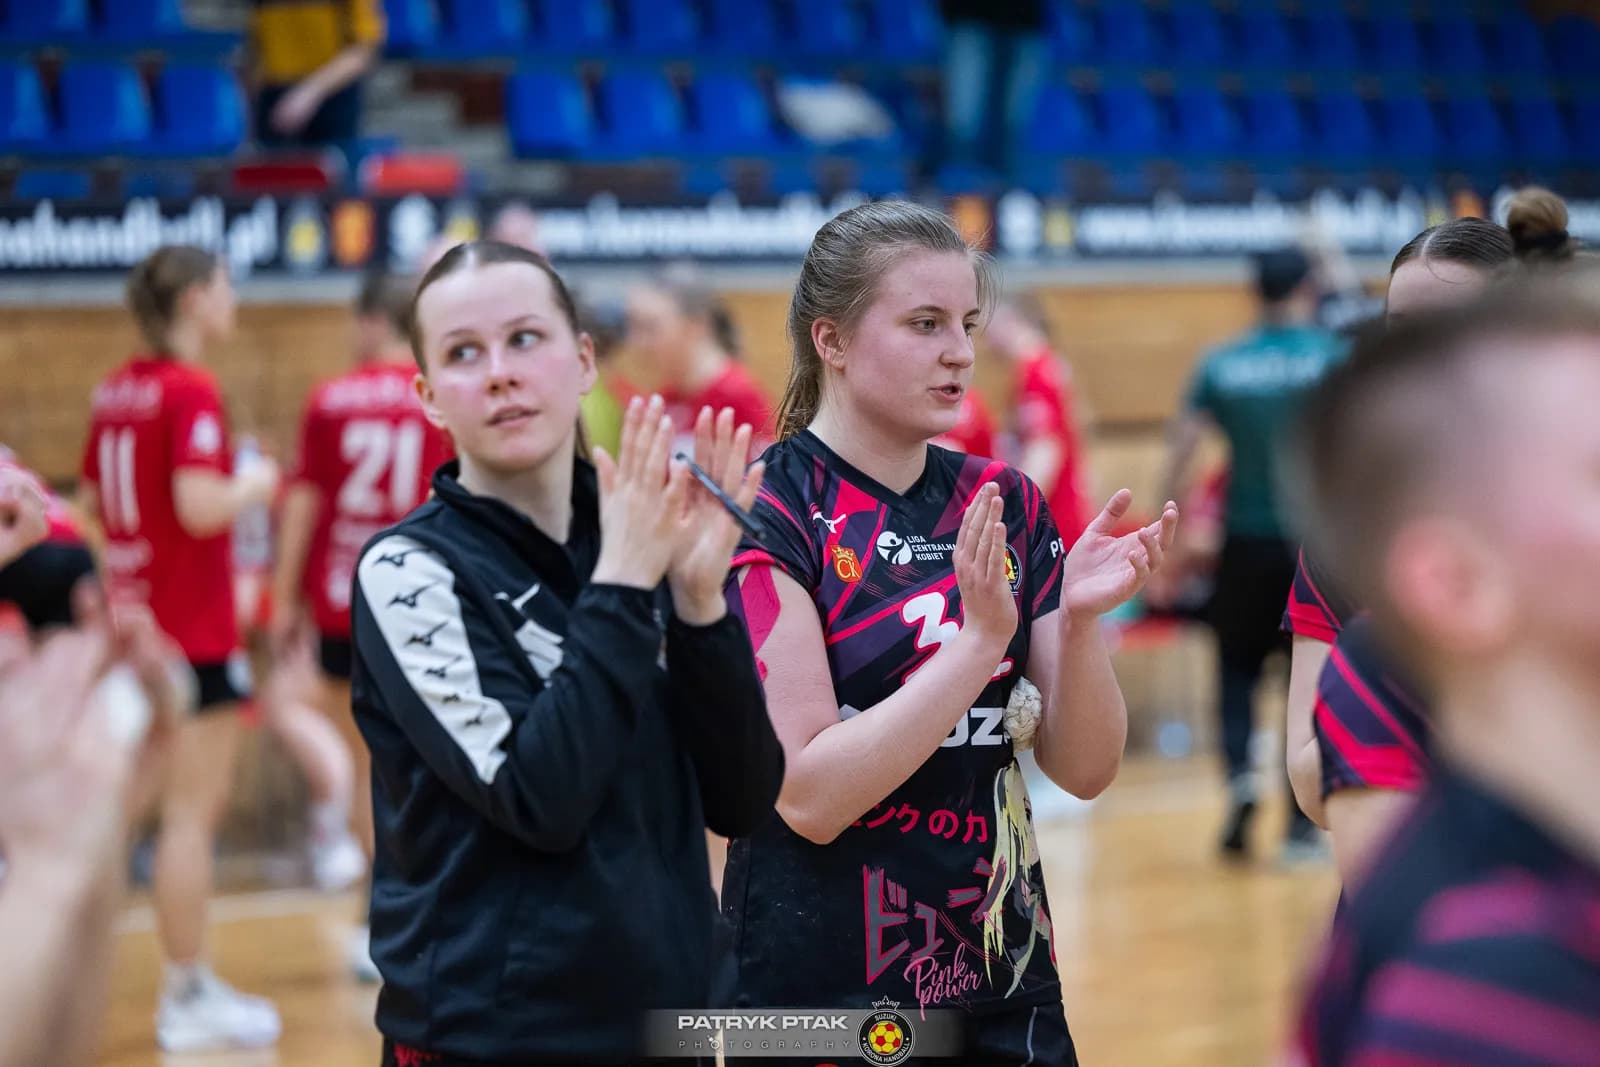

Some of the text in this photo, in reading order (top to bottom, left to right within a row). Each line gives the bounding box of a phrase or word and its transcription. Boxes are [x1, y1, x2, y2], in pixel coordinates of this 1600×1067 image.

[97, 426, 139, 534] 11
[338, 418, 426, 520] 21
[915, 552, 944, 560] KOBIET
[903, 942, 968, 999] Pink
[920, 970, 983, 1021] power
